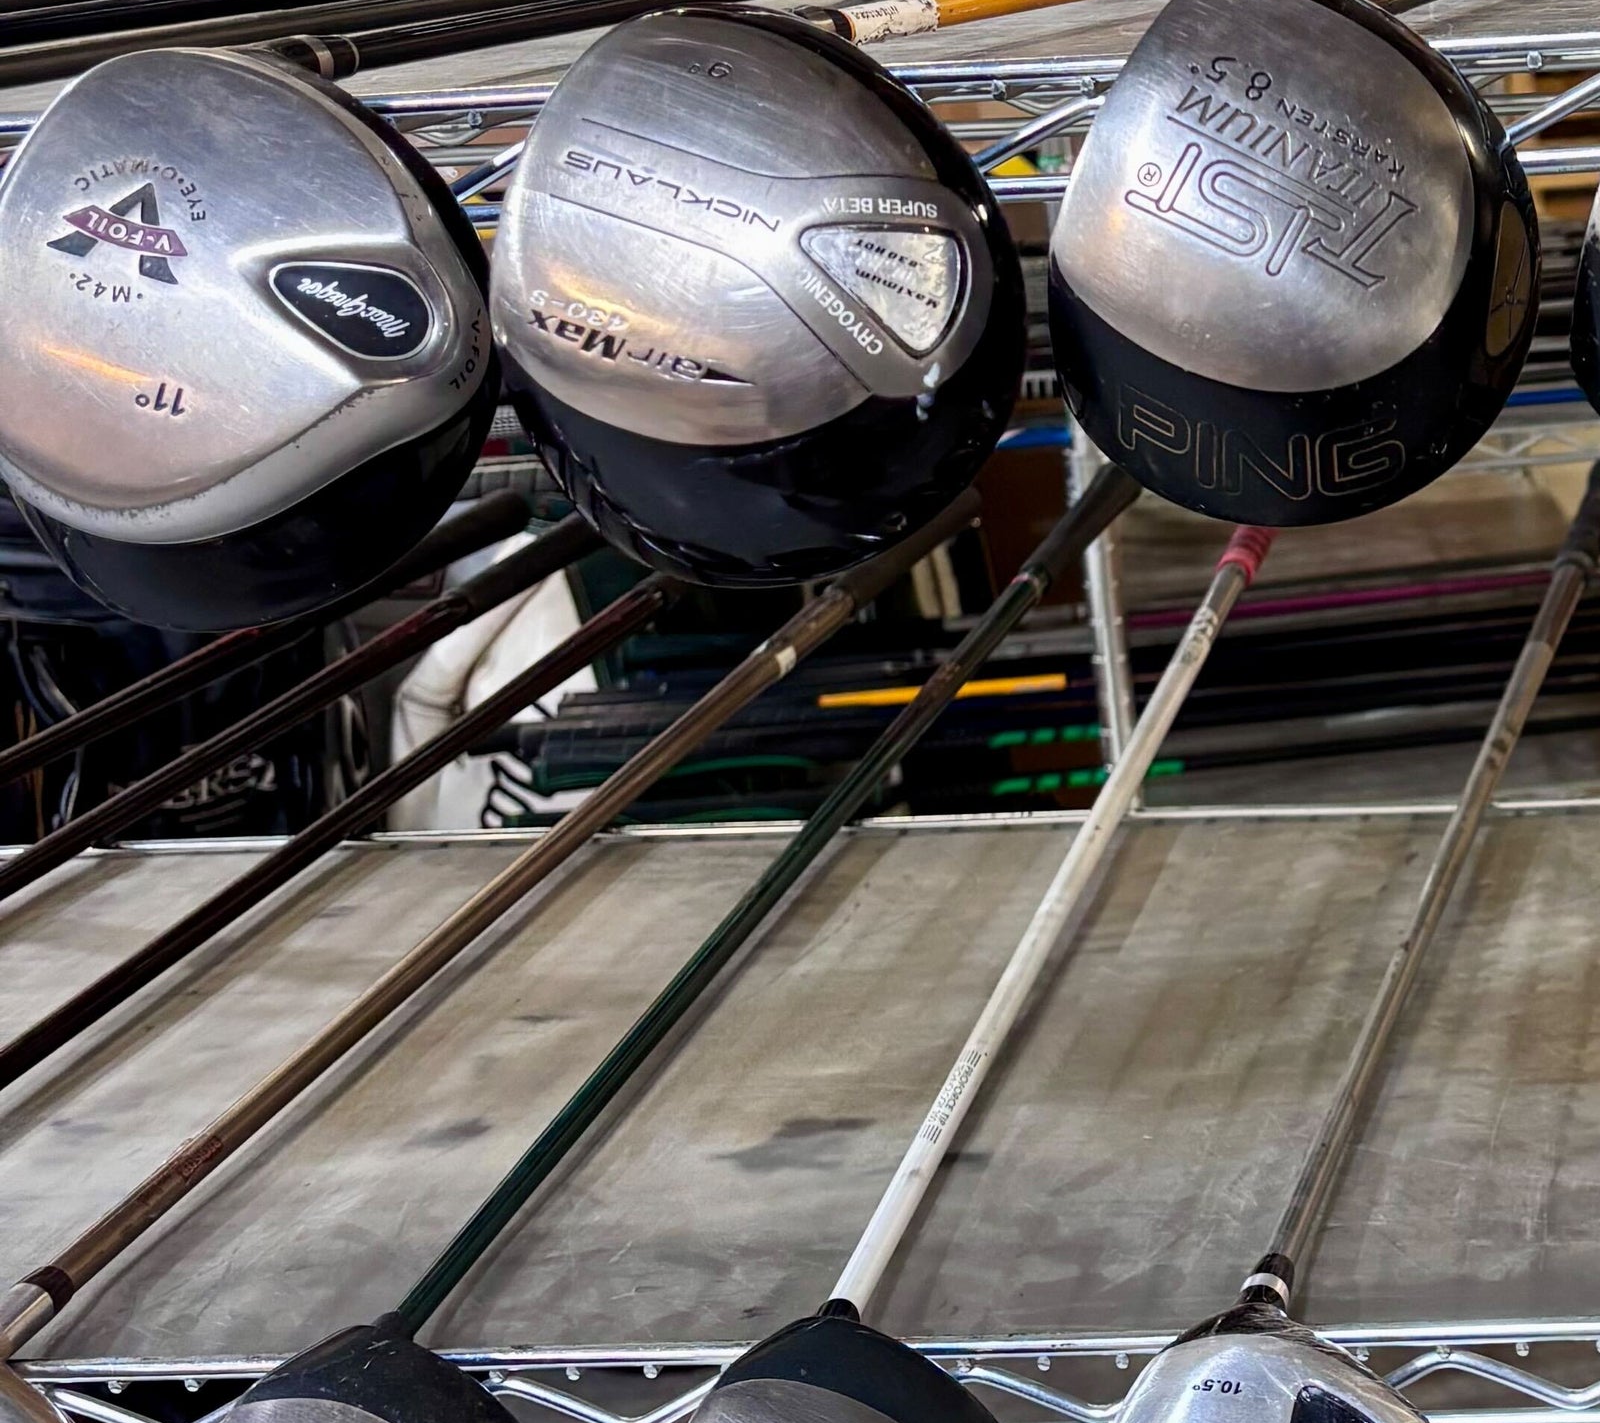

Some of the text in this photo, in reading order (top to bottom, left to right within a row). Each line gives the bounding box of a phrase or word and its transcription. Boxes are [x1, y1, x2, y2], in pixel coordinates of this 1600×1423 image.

[1277, 98, 1405, 177] KARSTEN
[565, 149, 780, 234] NICKLAUS
[822, 195, 938, 219] SUPER BETA
[86, 209, 173, 256] V-FOIL
[299, 276, 411, 340] MacGregor
[800, 269, 884, 356] CRYOGENIC
[1116, 386, 1406, 501] PING
